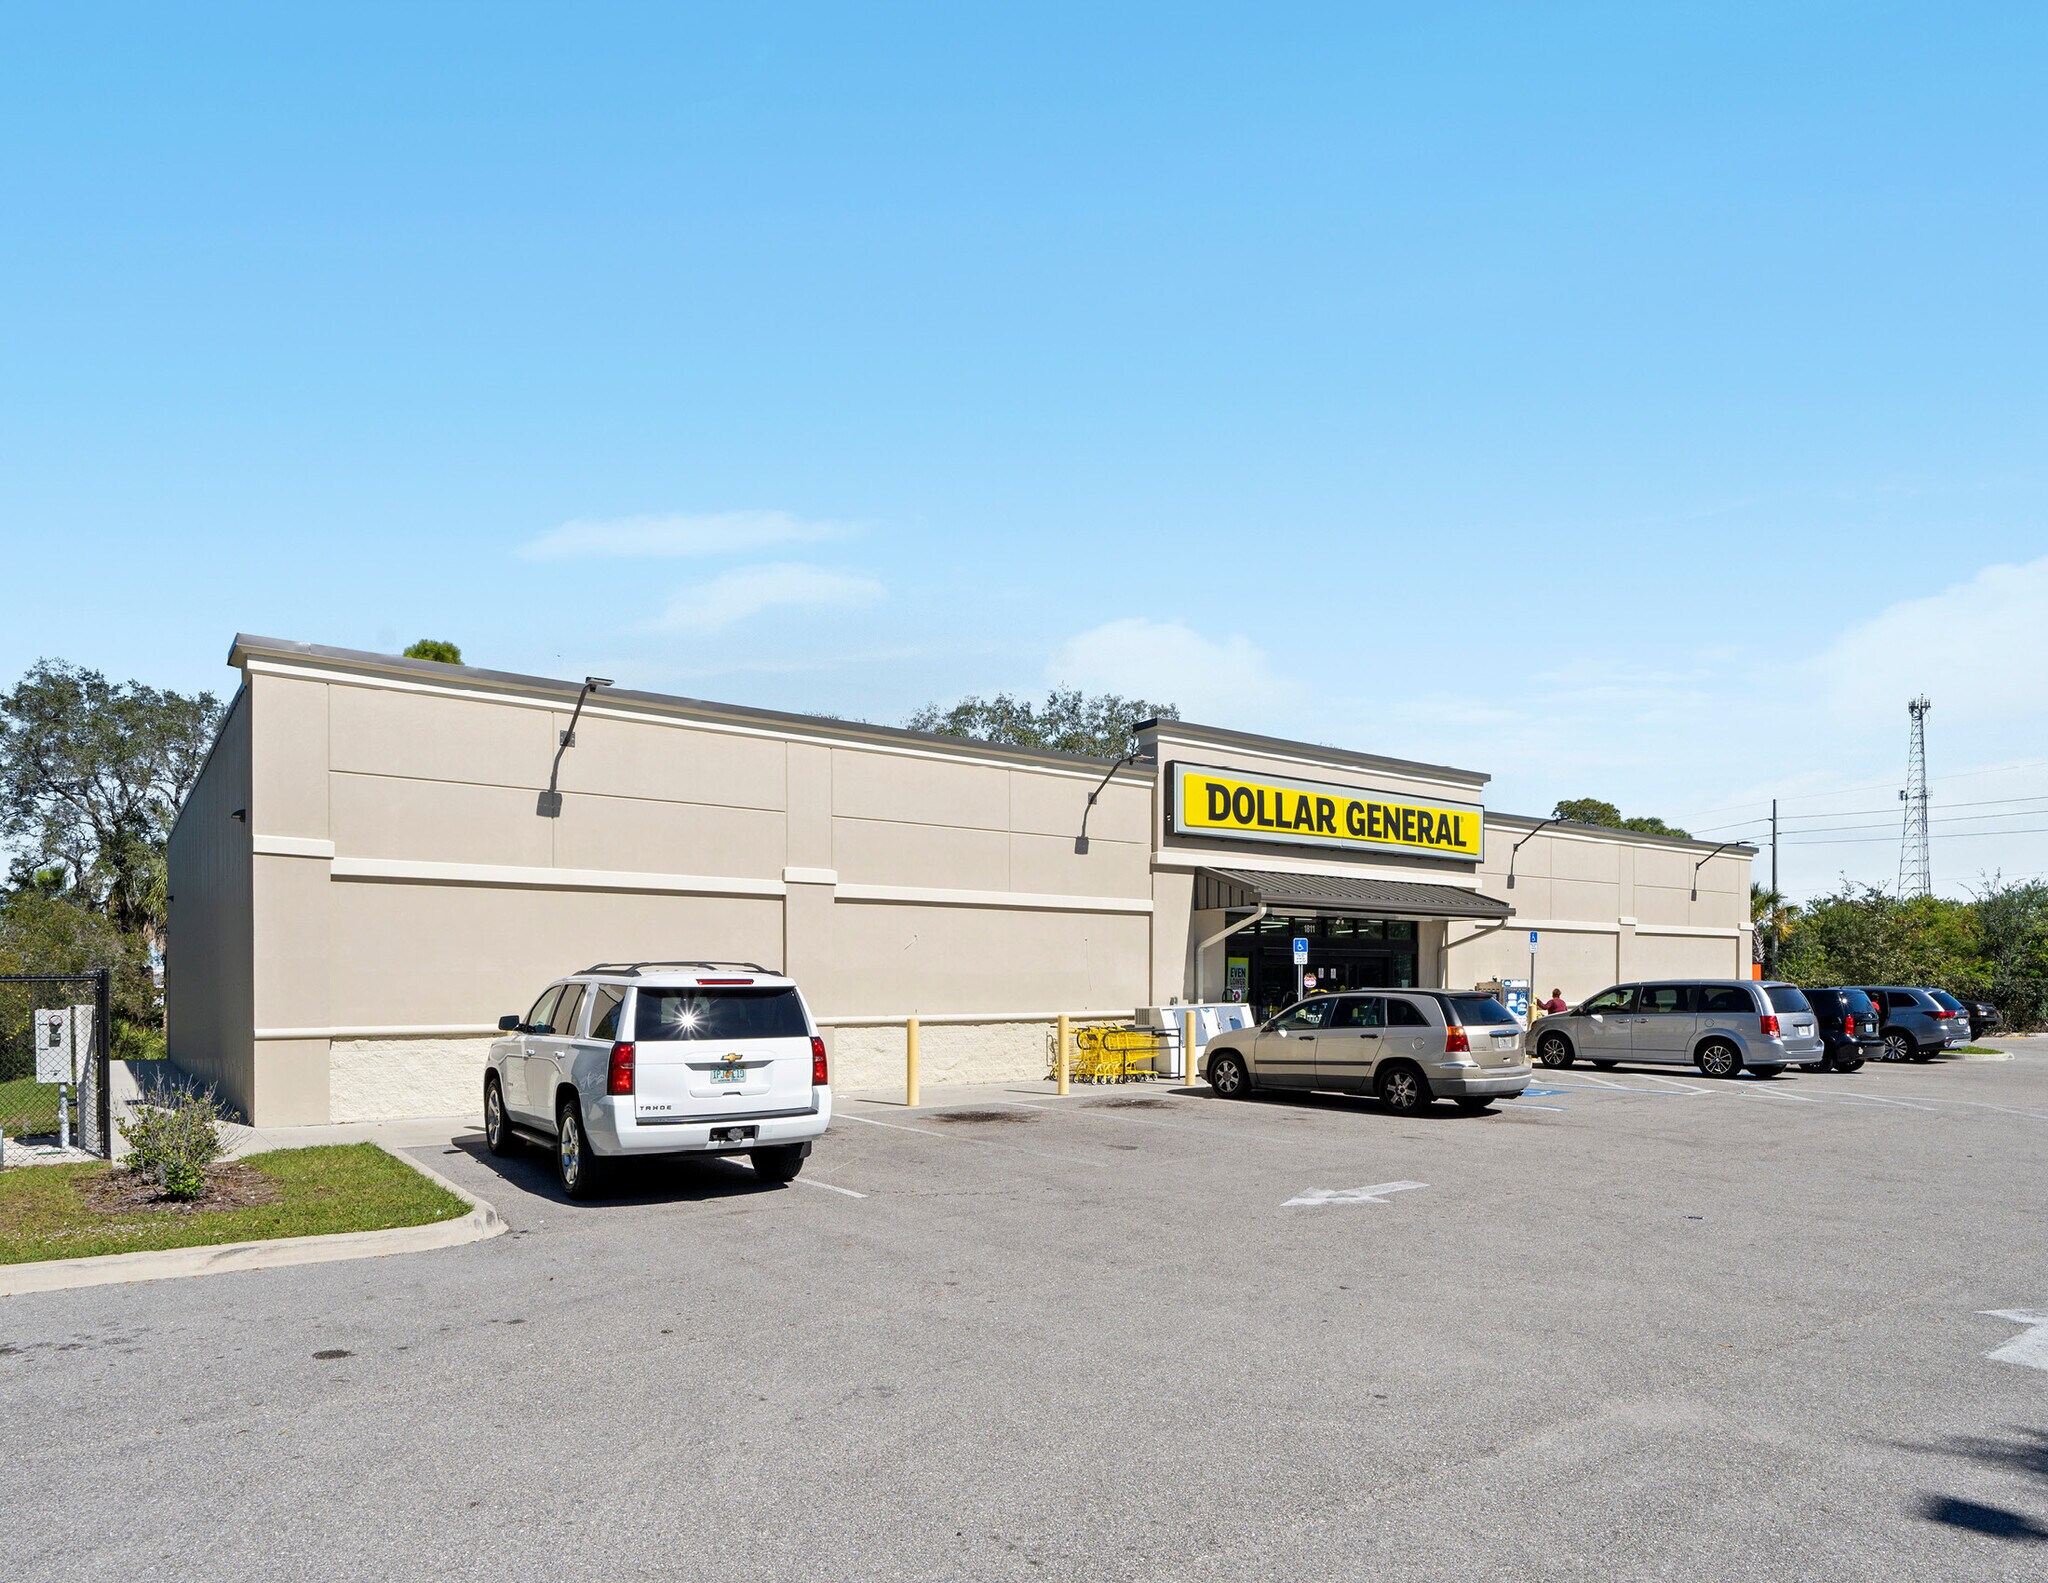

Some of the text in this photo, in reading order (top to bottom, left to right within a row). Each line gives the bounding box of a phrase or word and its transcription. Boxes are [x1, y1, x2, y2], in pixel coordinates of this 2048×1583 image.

[1206, 783, 1467, 847] DOLLAR GENERAL
[1230, 967, 1246, 978] EVEN
